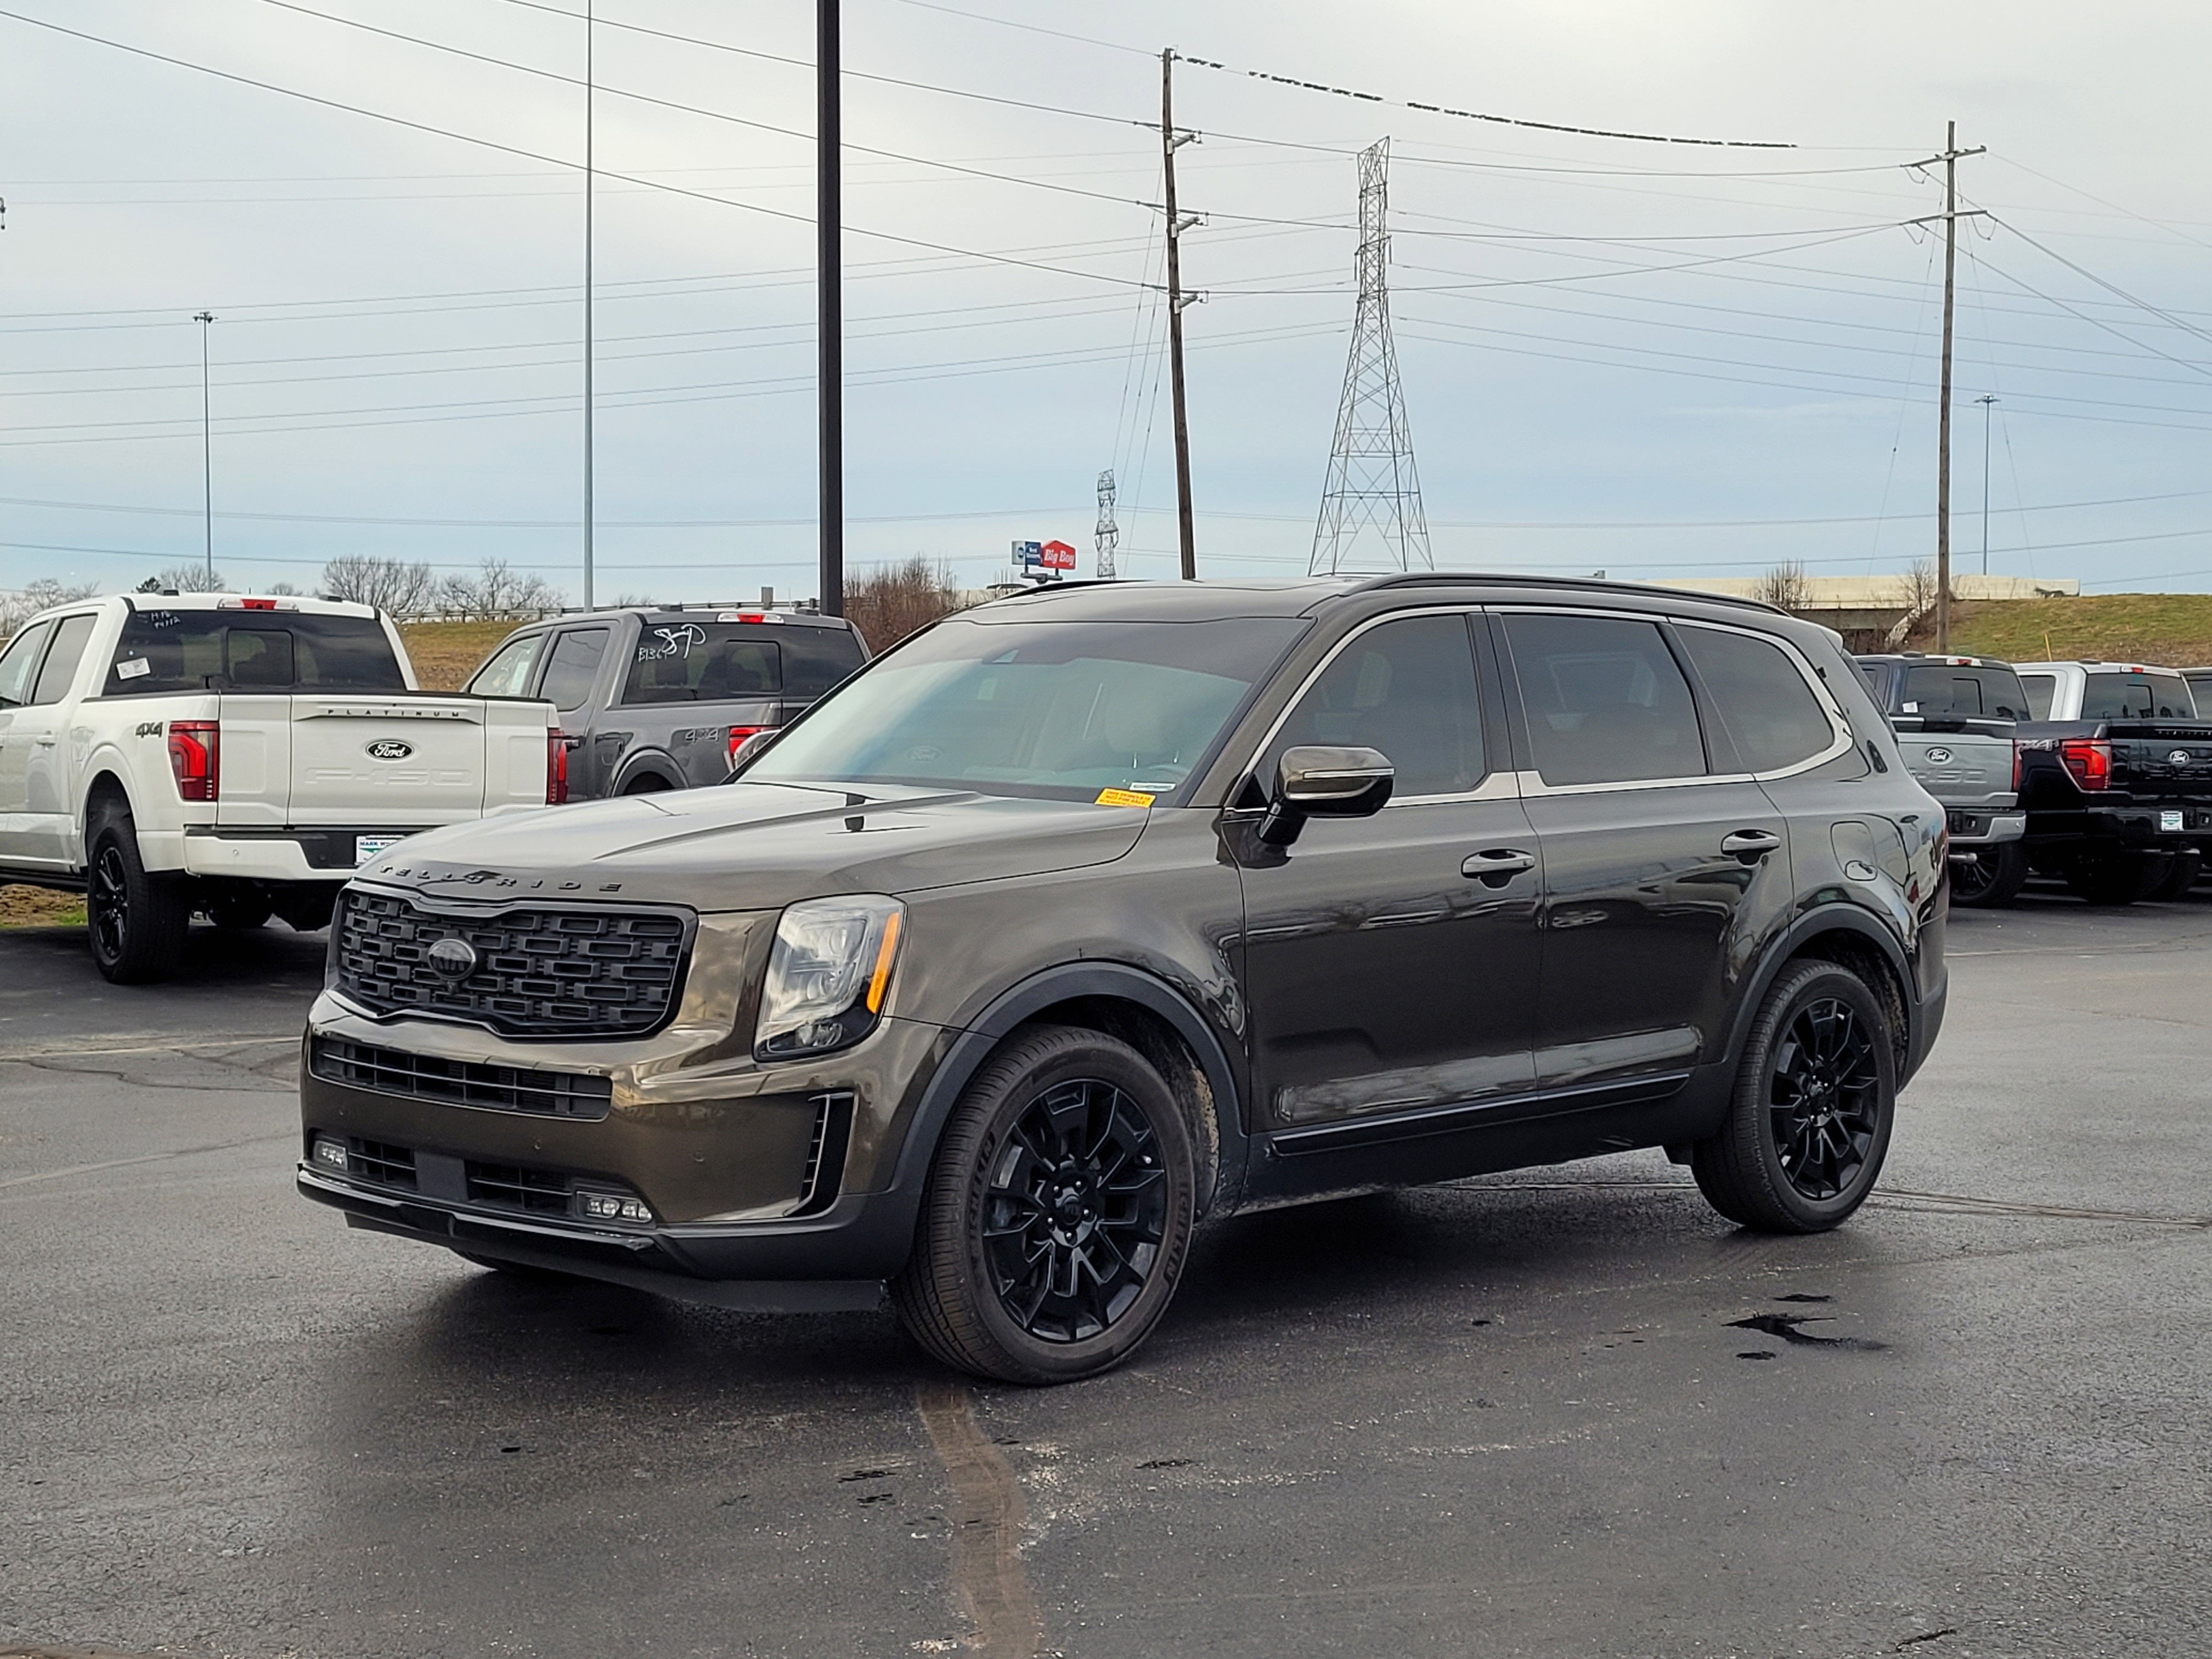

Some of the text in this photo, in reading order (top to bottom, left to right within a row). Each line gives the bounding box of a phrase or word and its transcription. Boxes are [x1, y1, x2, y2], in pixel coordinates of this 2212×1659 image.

[1044, 549, 1058, 564] Big
[374, 743, 405, 757] Ford
[305, 767, 473, 786] F-150
[380, 865, 622, 892] TELLURIDE
